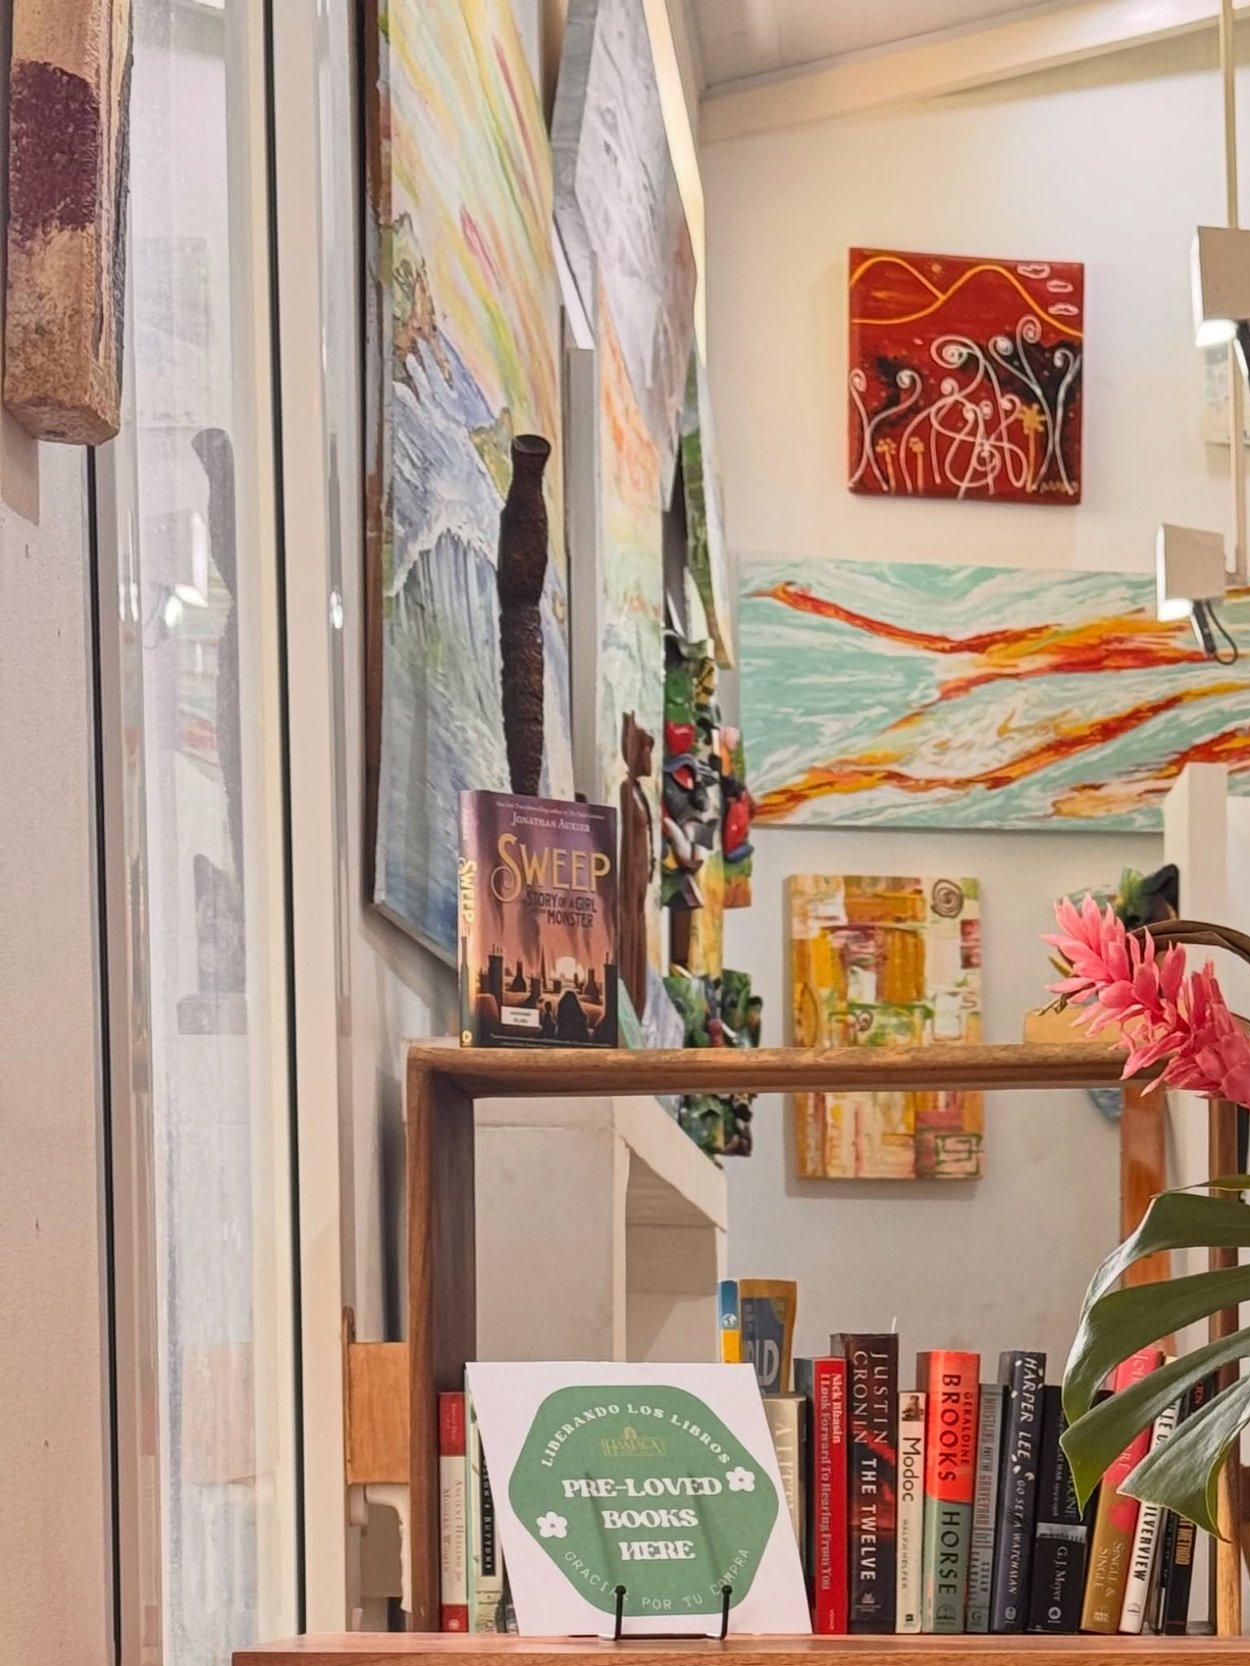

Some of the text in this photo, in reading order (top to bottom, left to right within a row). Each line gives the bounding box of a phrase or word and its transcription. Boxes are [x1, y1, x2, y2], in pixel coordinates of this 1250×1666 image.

[511, 812, 557, 827] JONATHAN
[459, 857, 477, 922] SWEEP
[491, 833, 611, 903] SWEEP
[527, 891, 558, 907] STORY
[575, 897, 597, 913] GIRL
[547, 911, 593, 927] MONSTER
[853, 1351, 867, 1443] CRONIN
[870, 1352, 888, 1444] JUSTIN
[938, 1374, 961, 1482] BROOKS
[961, 1392, 973, 1466] GERALDINE
[1018, 1357, 1037, 1459] HARPER LEE
[541, 1404, 620, 1468] LIBERANDO
[628, 1404, 664, 1418] LOS
[670, 1414, 730, 1464] LIBROS
[561, 1478, 722, 1498] PRE-LOVED
[902, 1437, 921, 1501] Modoc
[601, 1510, 699, 1529] BOOKS
[618, 1540, 696, 1561] HERE
[860, 1458, 877, 1580] THE TWELVE
[939, 1511, 960, 1594] HORSE
[642, 1598, 672, 1609] POR
[682, 1594, 703, 1608] TU
